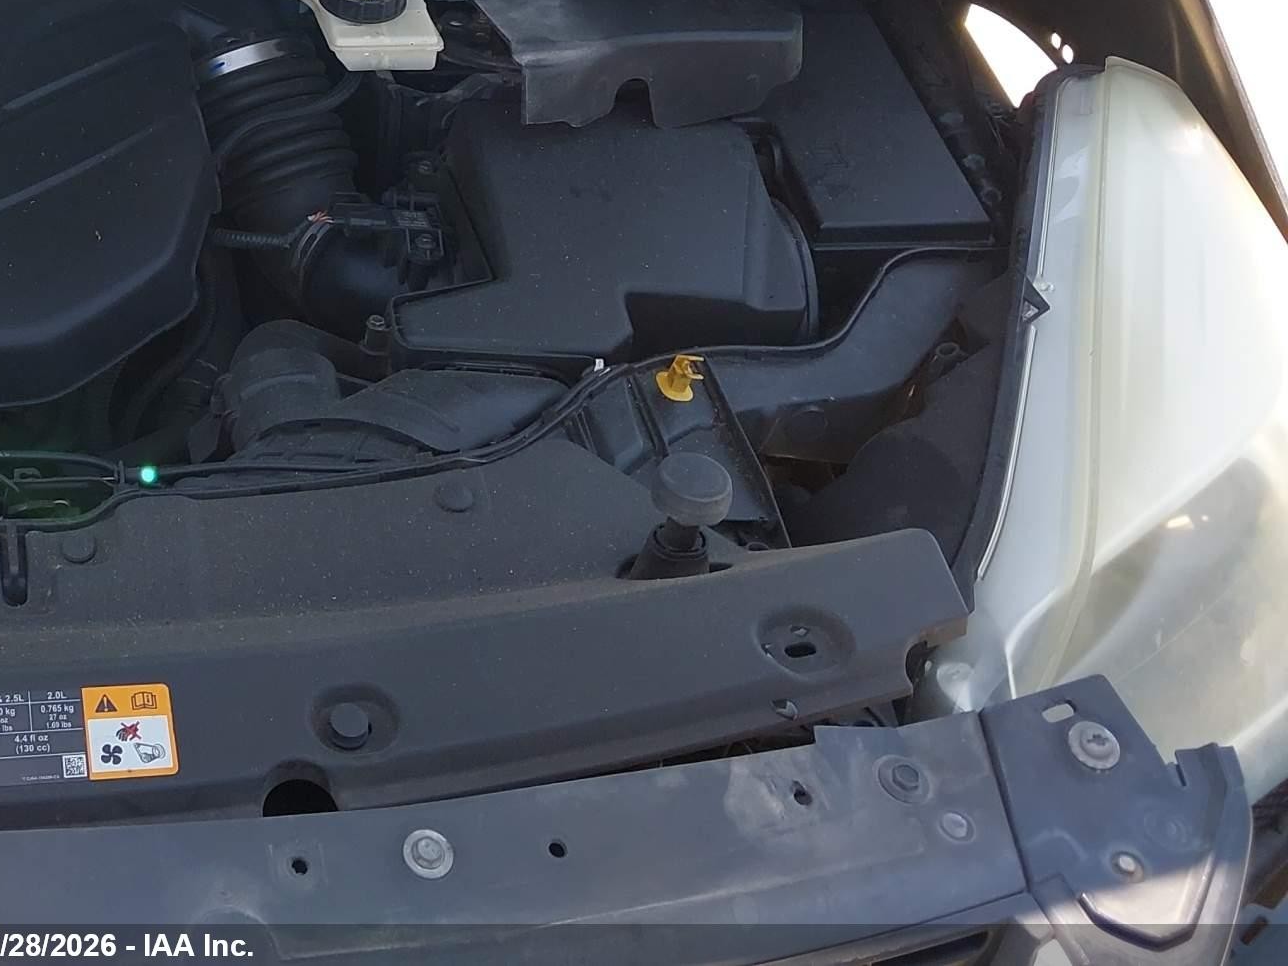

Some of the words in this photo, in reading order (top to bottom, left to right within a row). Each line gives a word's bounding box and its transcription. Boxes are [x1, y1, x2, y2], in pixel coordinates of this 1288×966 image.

[5, 693, 24, 703] 2.5L
[47, 690, 67, 700] 2.0L
[5, 707, 16, 717] kg
[40, 704, 62, 713] 0.765
[63, 704, 74, 714] kg
[2, 724, 13, 732] lbs
[14, 734, 28, 742] 4.4
[29, 733, 36, 742] fl
[15, 744, 35, 754] (130
[36, 743, 51, 753] cc)
